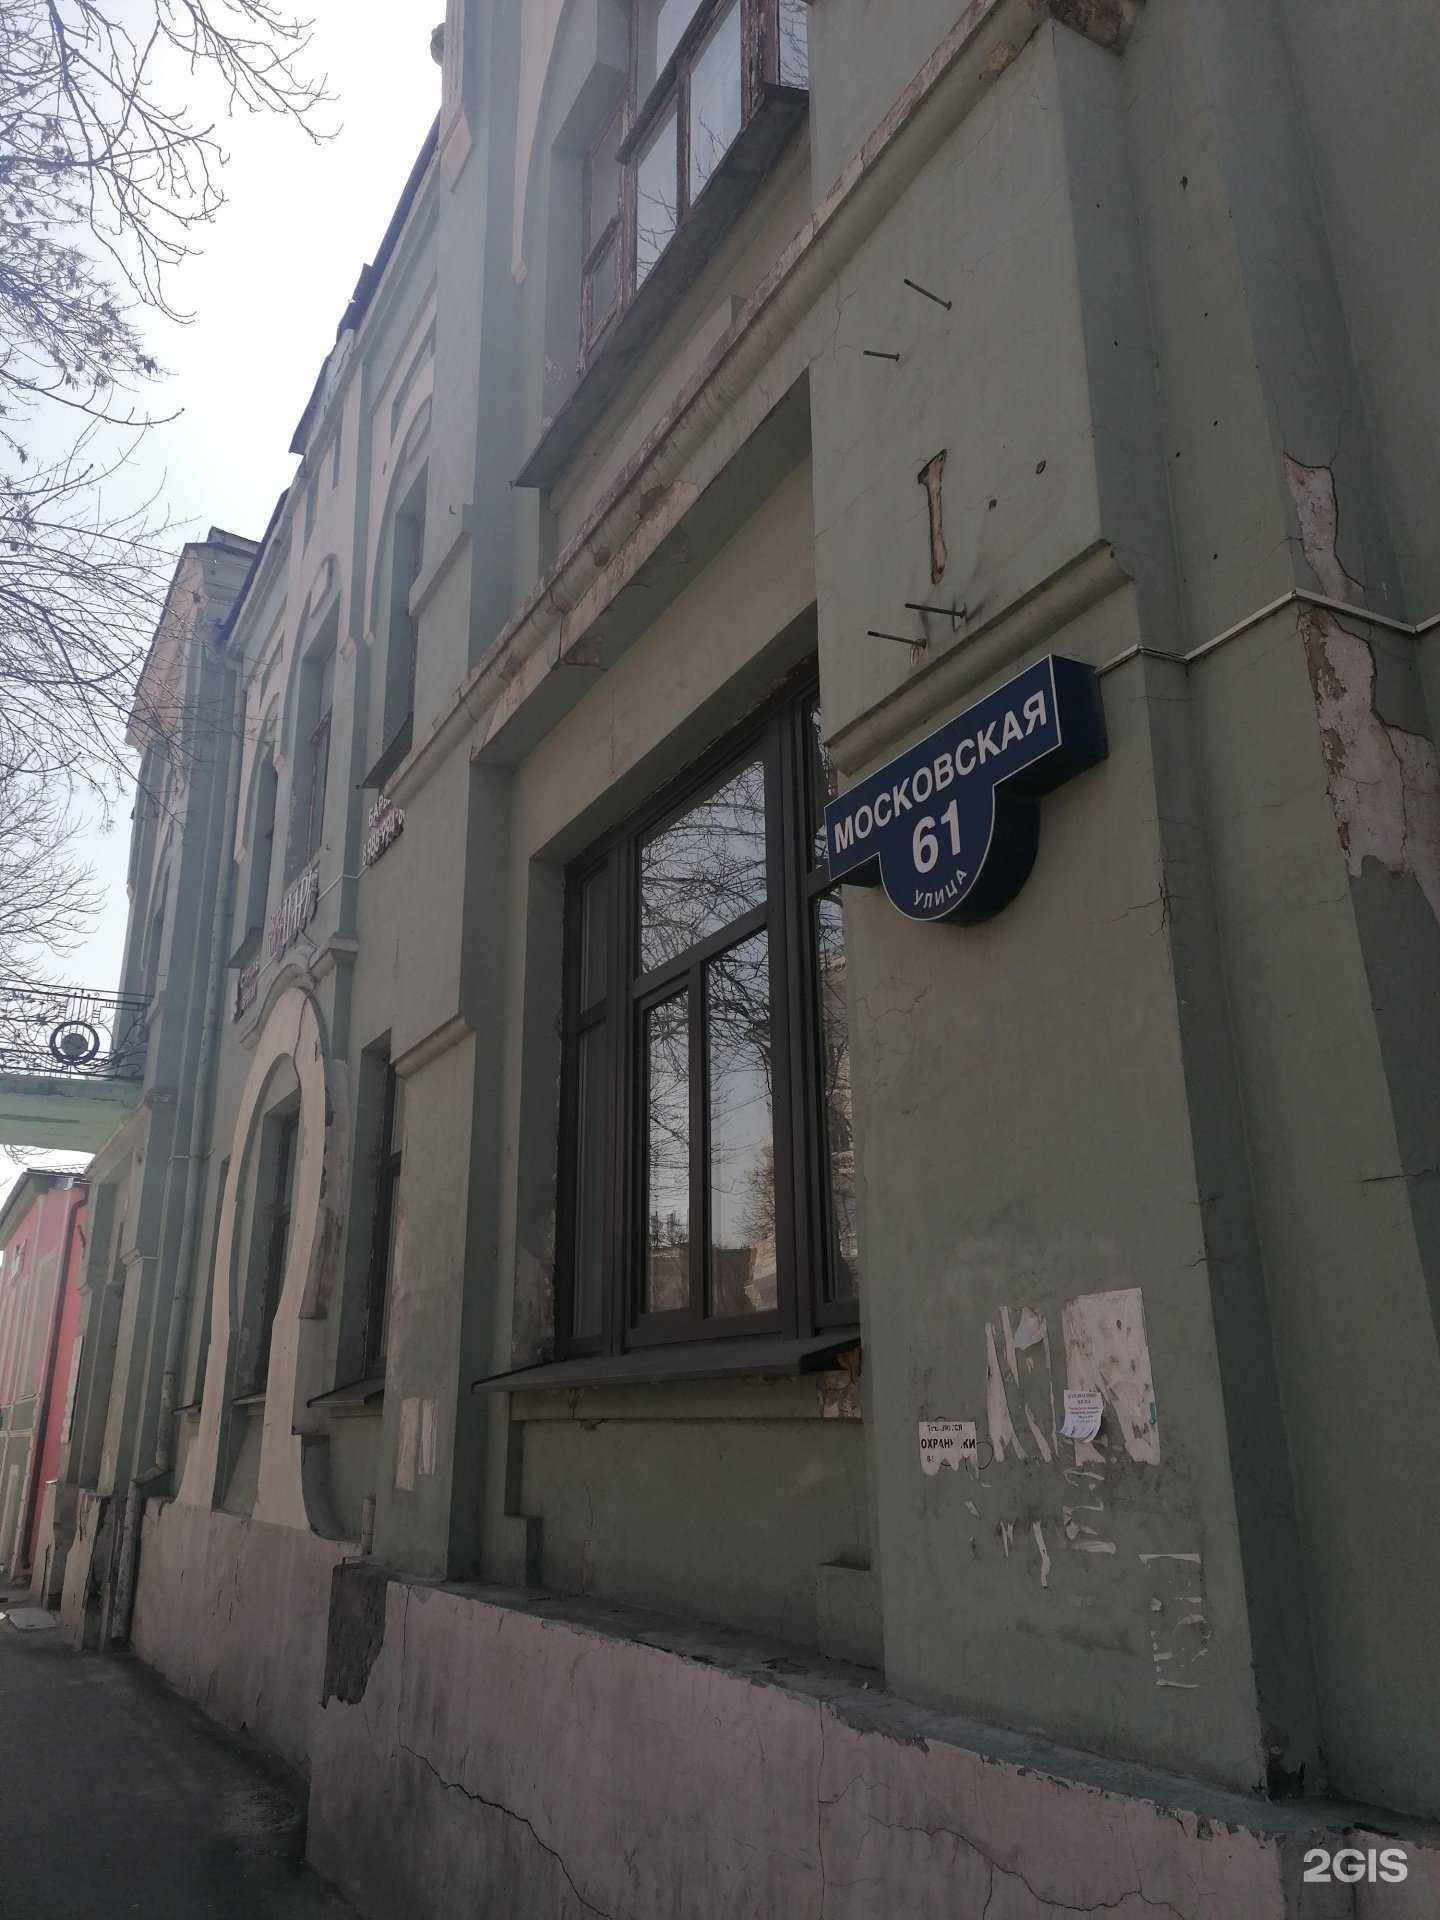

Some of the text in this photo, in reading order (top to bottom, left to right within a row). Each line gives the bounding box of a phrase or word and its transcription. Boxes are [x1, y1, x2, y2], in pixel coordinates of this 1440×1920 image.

[834, 690, 1047, 854] МОСКОВСКАЯ
[912, 799, 961, 874] 61
[914, 868, 968, 909] УЛИЦА
